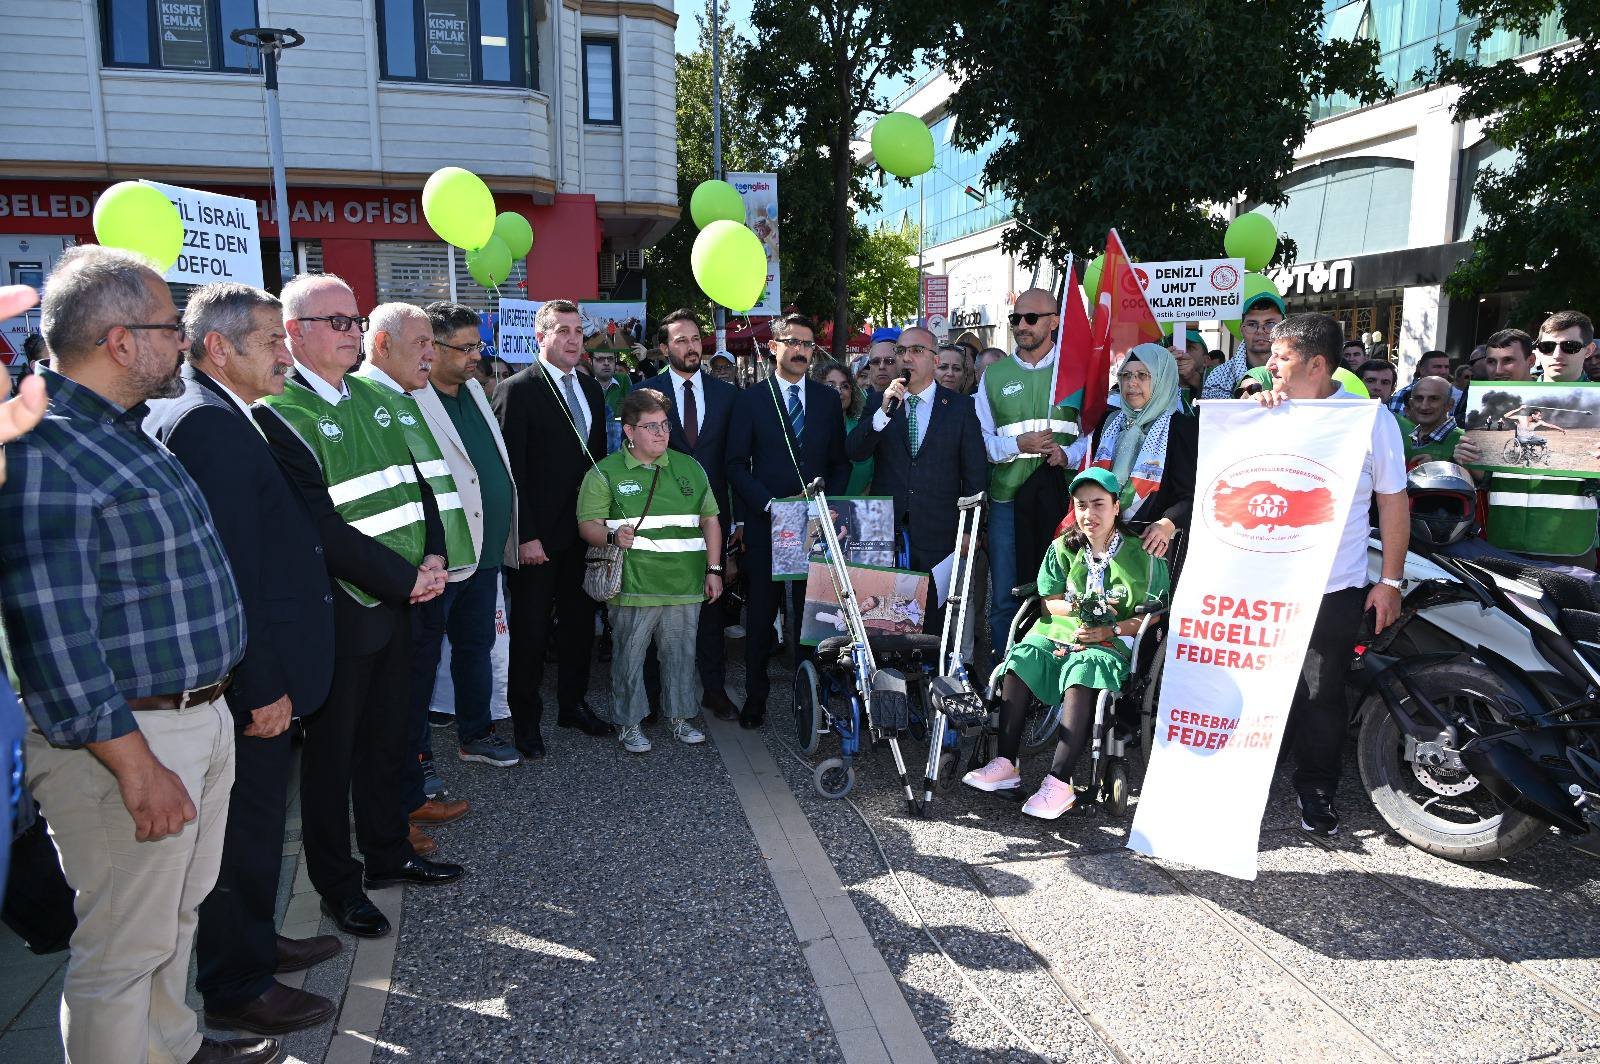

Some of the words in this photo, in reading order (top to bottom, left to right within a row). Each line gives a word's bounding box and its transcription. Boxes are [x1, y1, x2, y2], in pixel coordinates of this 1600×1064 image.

[161, 3, 202, 15] KISMET
[162, 14, 202, 27] EMLAK
[429, 18, 466, 30] KISMET
[429, 30, 465, 42] EMLAK
[170, 197, 195, 222] İL
[197, 200, 251, 231] İSRAİL
[343, 197, 419, 225] OFİSİ
[182, 228, 211, 250] ZZE
[214, 233, 248, 255] DEN
[177, 253, 233, 277] DEFOL
[1155, 264, 1204, 280] DENİZLİ
[1161, 282, 1197, 294] UMUT
[1188, 292, 1240, 307] DERNEĞİ
